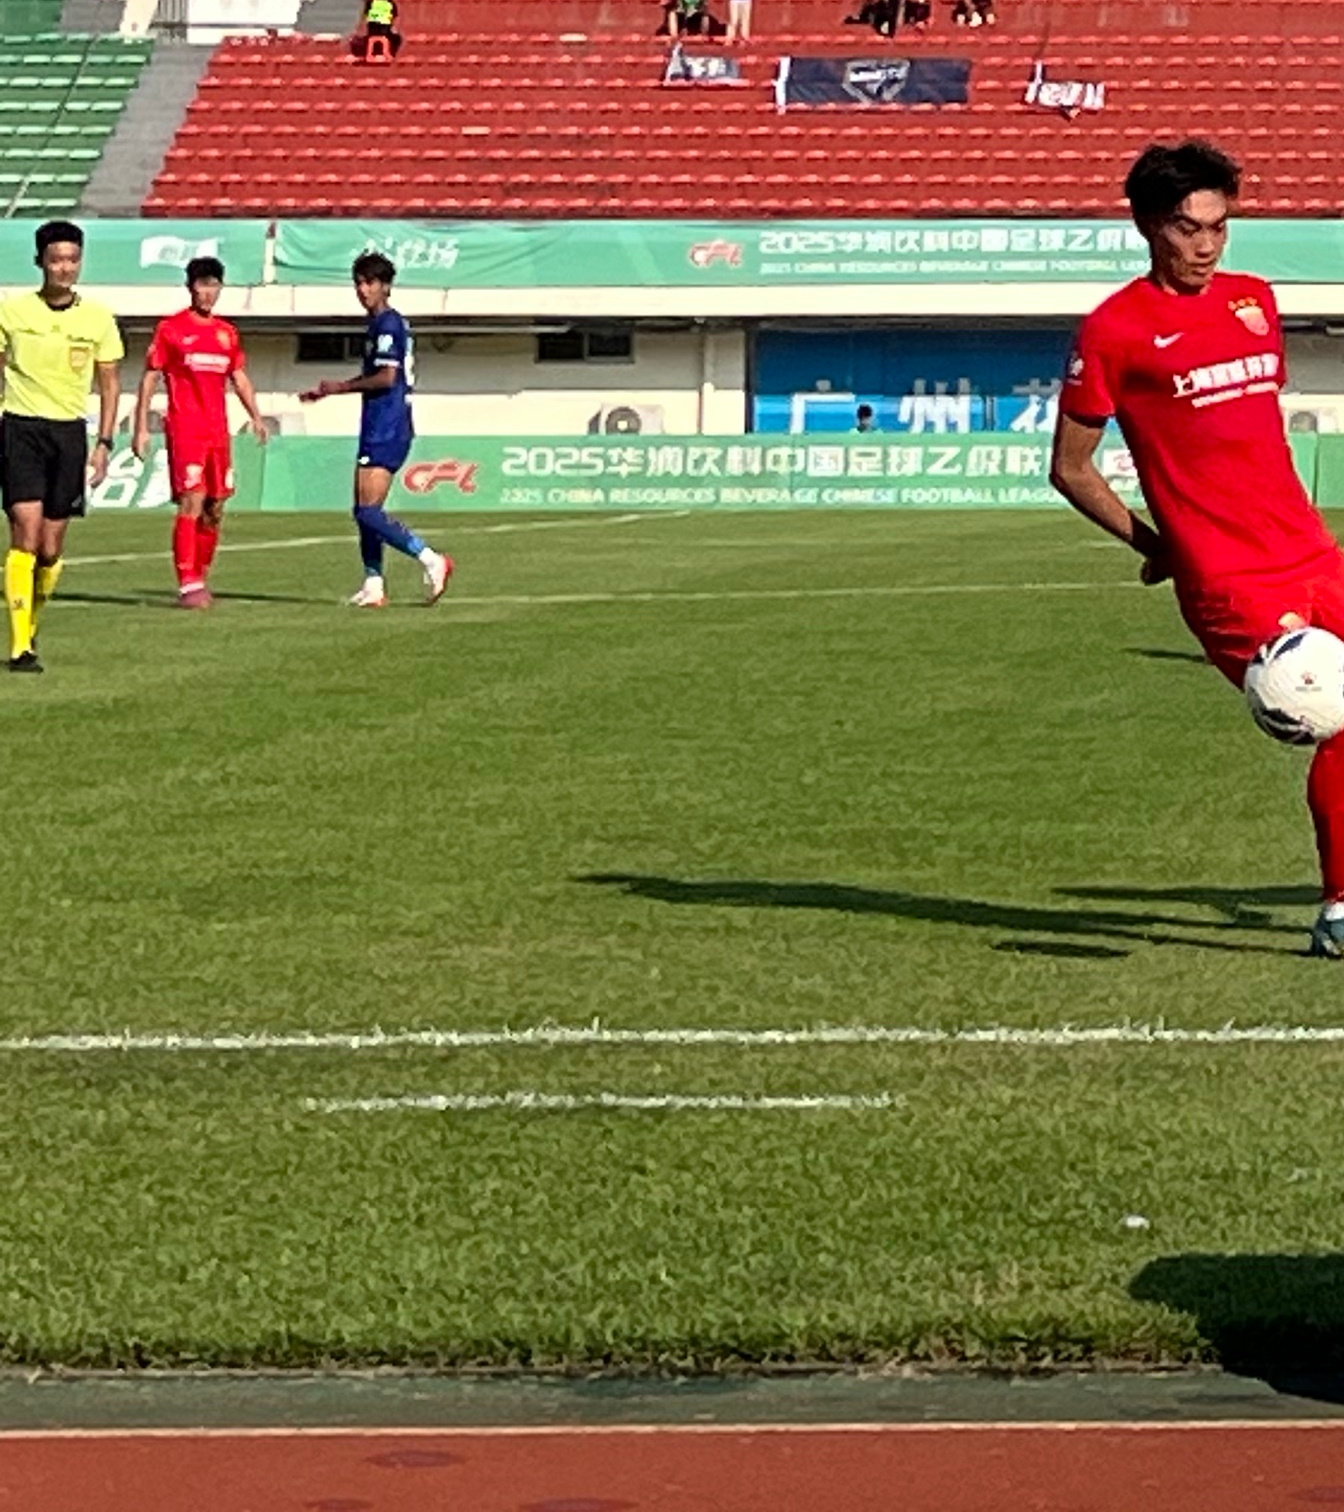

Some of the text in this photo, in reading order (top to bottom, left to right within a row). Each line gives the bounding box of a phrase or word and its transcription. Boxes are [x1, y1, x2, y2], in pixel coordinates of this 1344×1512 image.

[501, 445, 1053, 478] 2025华润饮料中国足球乙级联
